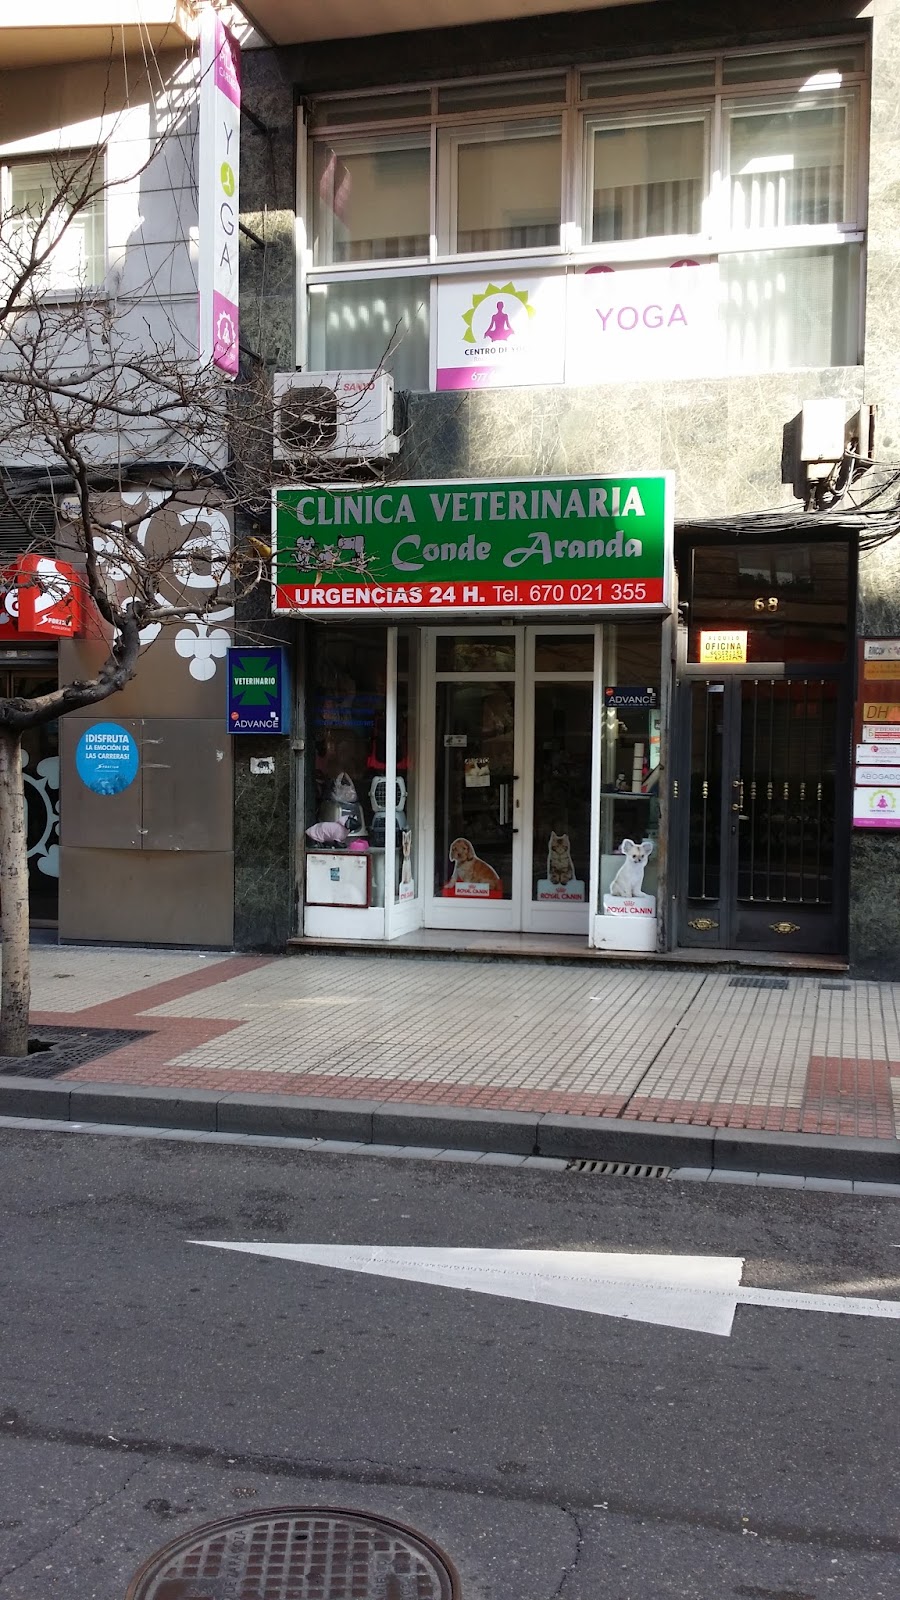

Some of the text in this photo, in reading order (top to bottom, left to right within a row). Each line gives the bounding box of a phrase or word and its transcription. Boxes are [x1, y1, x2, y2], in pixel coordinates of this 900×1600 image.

[595, 303, 688, 332] YOGA
[464, 347, 497, 356] CENTRO
[343, 382, 376, 391] SANYO
[296, 486, 646, 526] CLINICA VETERINARIA
[391, 530, 643, 572] Conde Aranda
[294, 583, 647, 605] URGENCIAS 24 H. Tel. 670 021 355
[754, 597, 779, 612] 68
[705, 642, 742, 651] OFICINA
[234, 677, 276, 685] VETERINARIO
[608, 695, 657, 704] ADVANCE
[234, 719, 279, 729] ADVANCE
[93, 743, 121, 751] EMOCIÓN
[629, 907, 652, 915] CANIN
